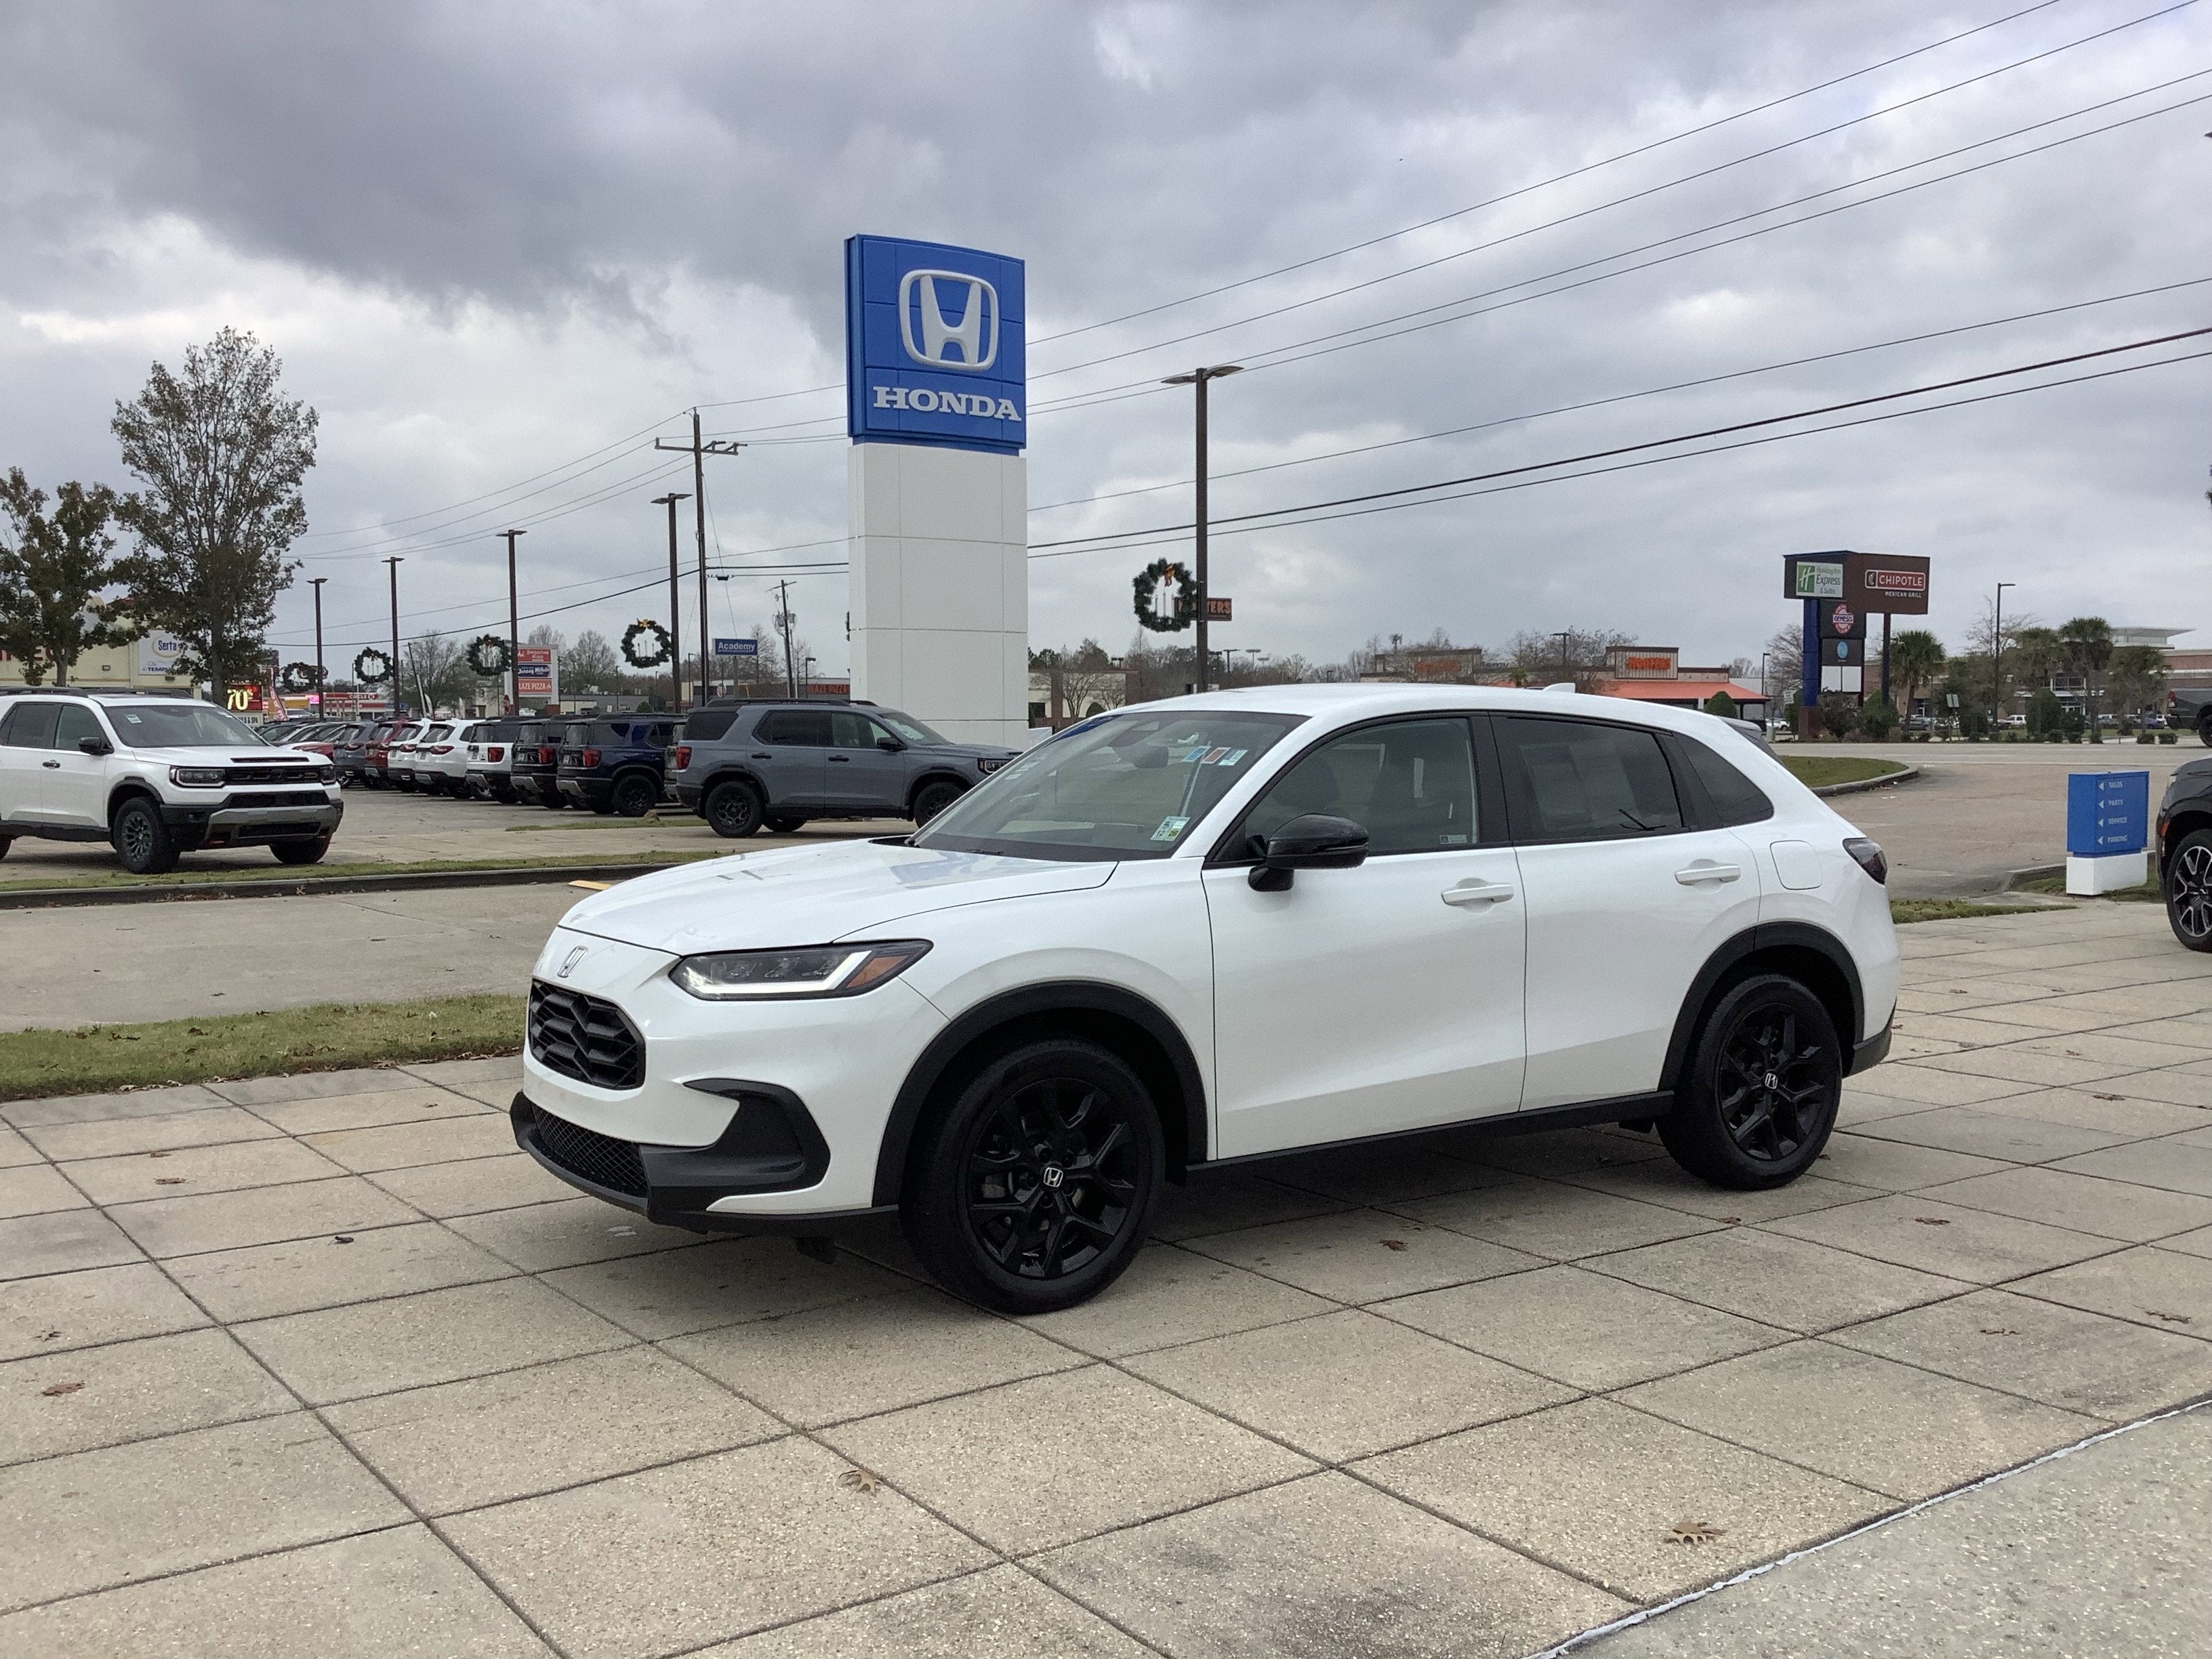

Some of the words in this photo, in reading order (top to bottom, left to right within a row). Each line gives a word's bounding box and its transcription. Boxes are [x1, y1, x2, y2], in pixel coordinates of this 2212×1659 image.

[873, 386, 1021, 422] HONDA
[1816, 574, 1841, 586] Express
[1879, 575, 1923, 586] CHIPOTLE
[158, 640, 177, 651] Serta
[718, 641, 756, 651] Academy
